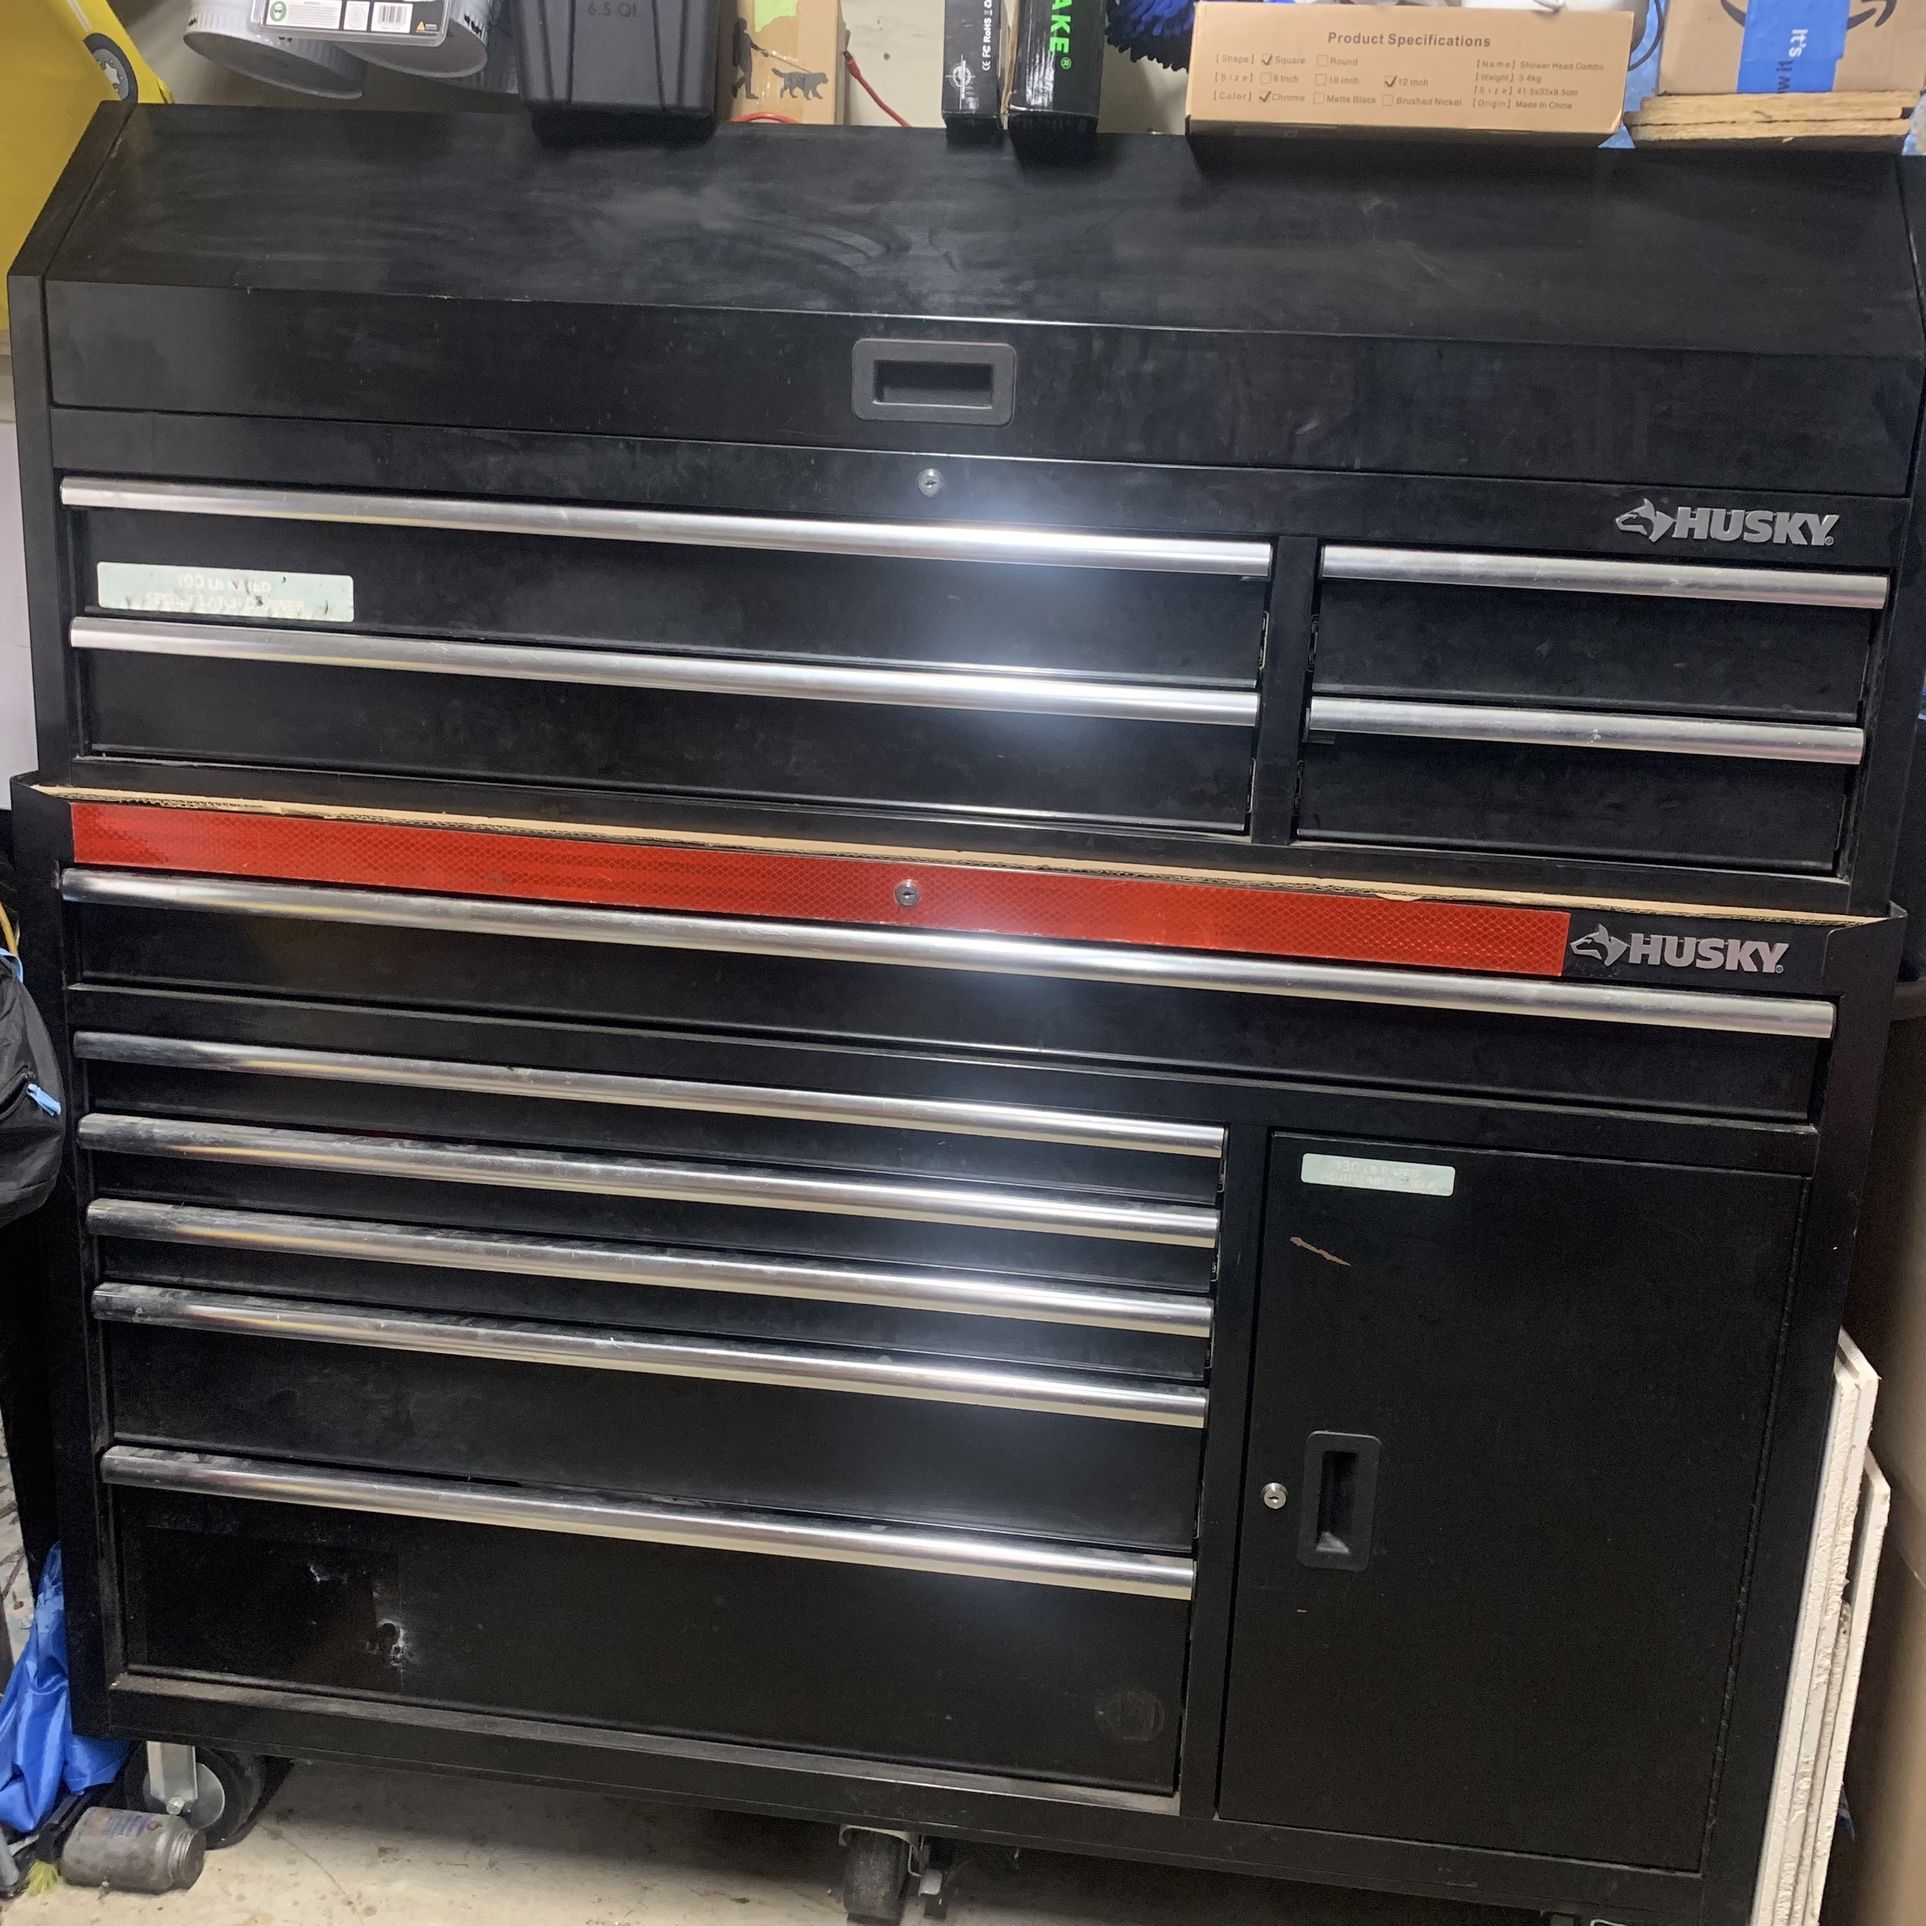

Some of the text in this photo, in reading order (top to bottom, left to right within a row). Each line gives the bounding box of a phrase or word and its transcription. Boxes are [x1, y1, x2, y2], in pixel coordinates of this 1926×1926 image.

[983, 17, 992, 43] RoHS
[1328, 32, 1491, 48] Product Specifications
[1788, 29, 1808, 58] It's
[1274, 55, 1306, 65] Square
[1329, 57, 1358, 66] Round
[1520, 61, 1550, 69] Shower
[1552, 62, 1574, 70] Head
[1575, 62, 1604, 70] Combo
[1329, 76, 1339, 84] 10
[1398, 78, 1408, 86] 12
[1271, 92, 1305, 102] Chrome
[1326, 95, 1351, 103] Matte
[1353, 95, 1376, 104] Black
[1396, 96, 1433, 106] Brushed
[1434, 97, 1462, 106] Nickel
[1515, 101, 1537, 109] Made
[1548, 101, 1572, 109] China
[1672, 506, 1840, 546] HUSKY
[1629, 932, 1789, 974] HUSKY
